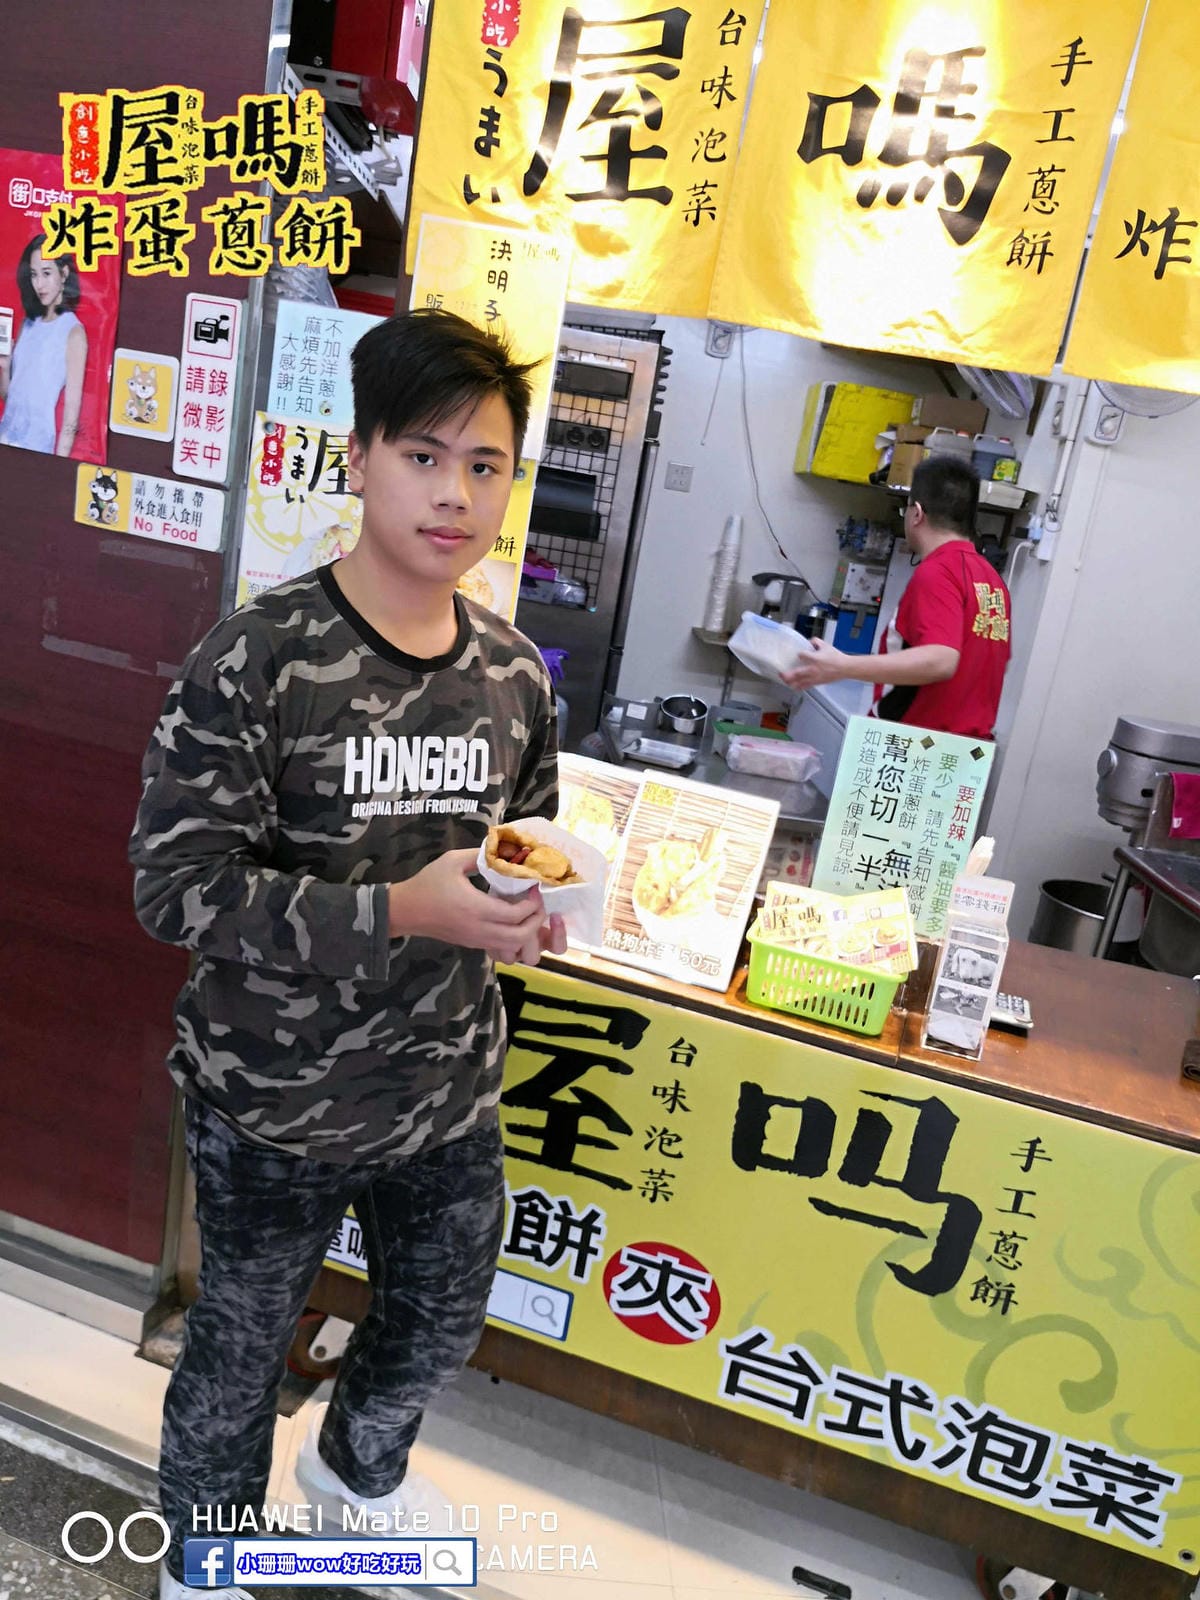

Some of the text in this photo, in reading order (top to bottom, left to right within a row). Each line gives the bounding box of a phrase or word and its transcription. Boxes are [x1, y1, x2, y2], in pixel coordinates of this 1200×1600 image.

[463, 48, 508, 206] うまい
[523, 6, 692, 207] 屋
[682, 8, 747, 227] 台味泡菜
[797, 45, 1012, 246] 嗎
[1006, 36, 1093, 275] 手工蔥餅
[9, 178, 73, 210] 街口支付
[1114, 206, 1199, 280] 炸
[294, 316, 323, 414] 麻煩先告知
[318, 318, 344, 399] 不加洋蔥
[179, 366, 206, 466] 請微笑
[202, 369, 229, 468] 錄影中
[285, 425, 308, 504] うまい
[134, 499, 203, 529] 外食進入食用
[134, 517, 198, 543] No Food
[494, 535, 517, 557] 餅
[343, 736, 490, 795] HONGBO
[393, 799, 424, 815] DESIGN
[638, 1036, 699, 1203] 台味泡菜
[968, 1136, 1053, 1316] 手工蔥餅
[503, 1189, 1176, 1541] 餅 夾 台式泡菜
